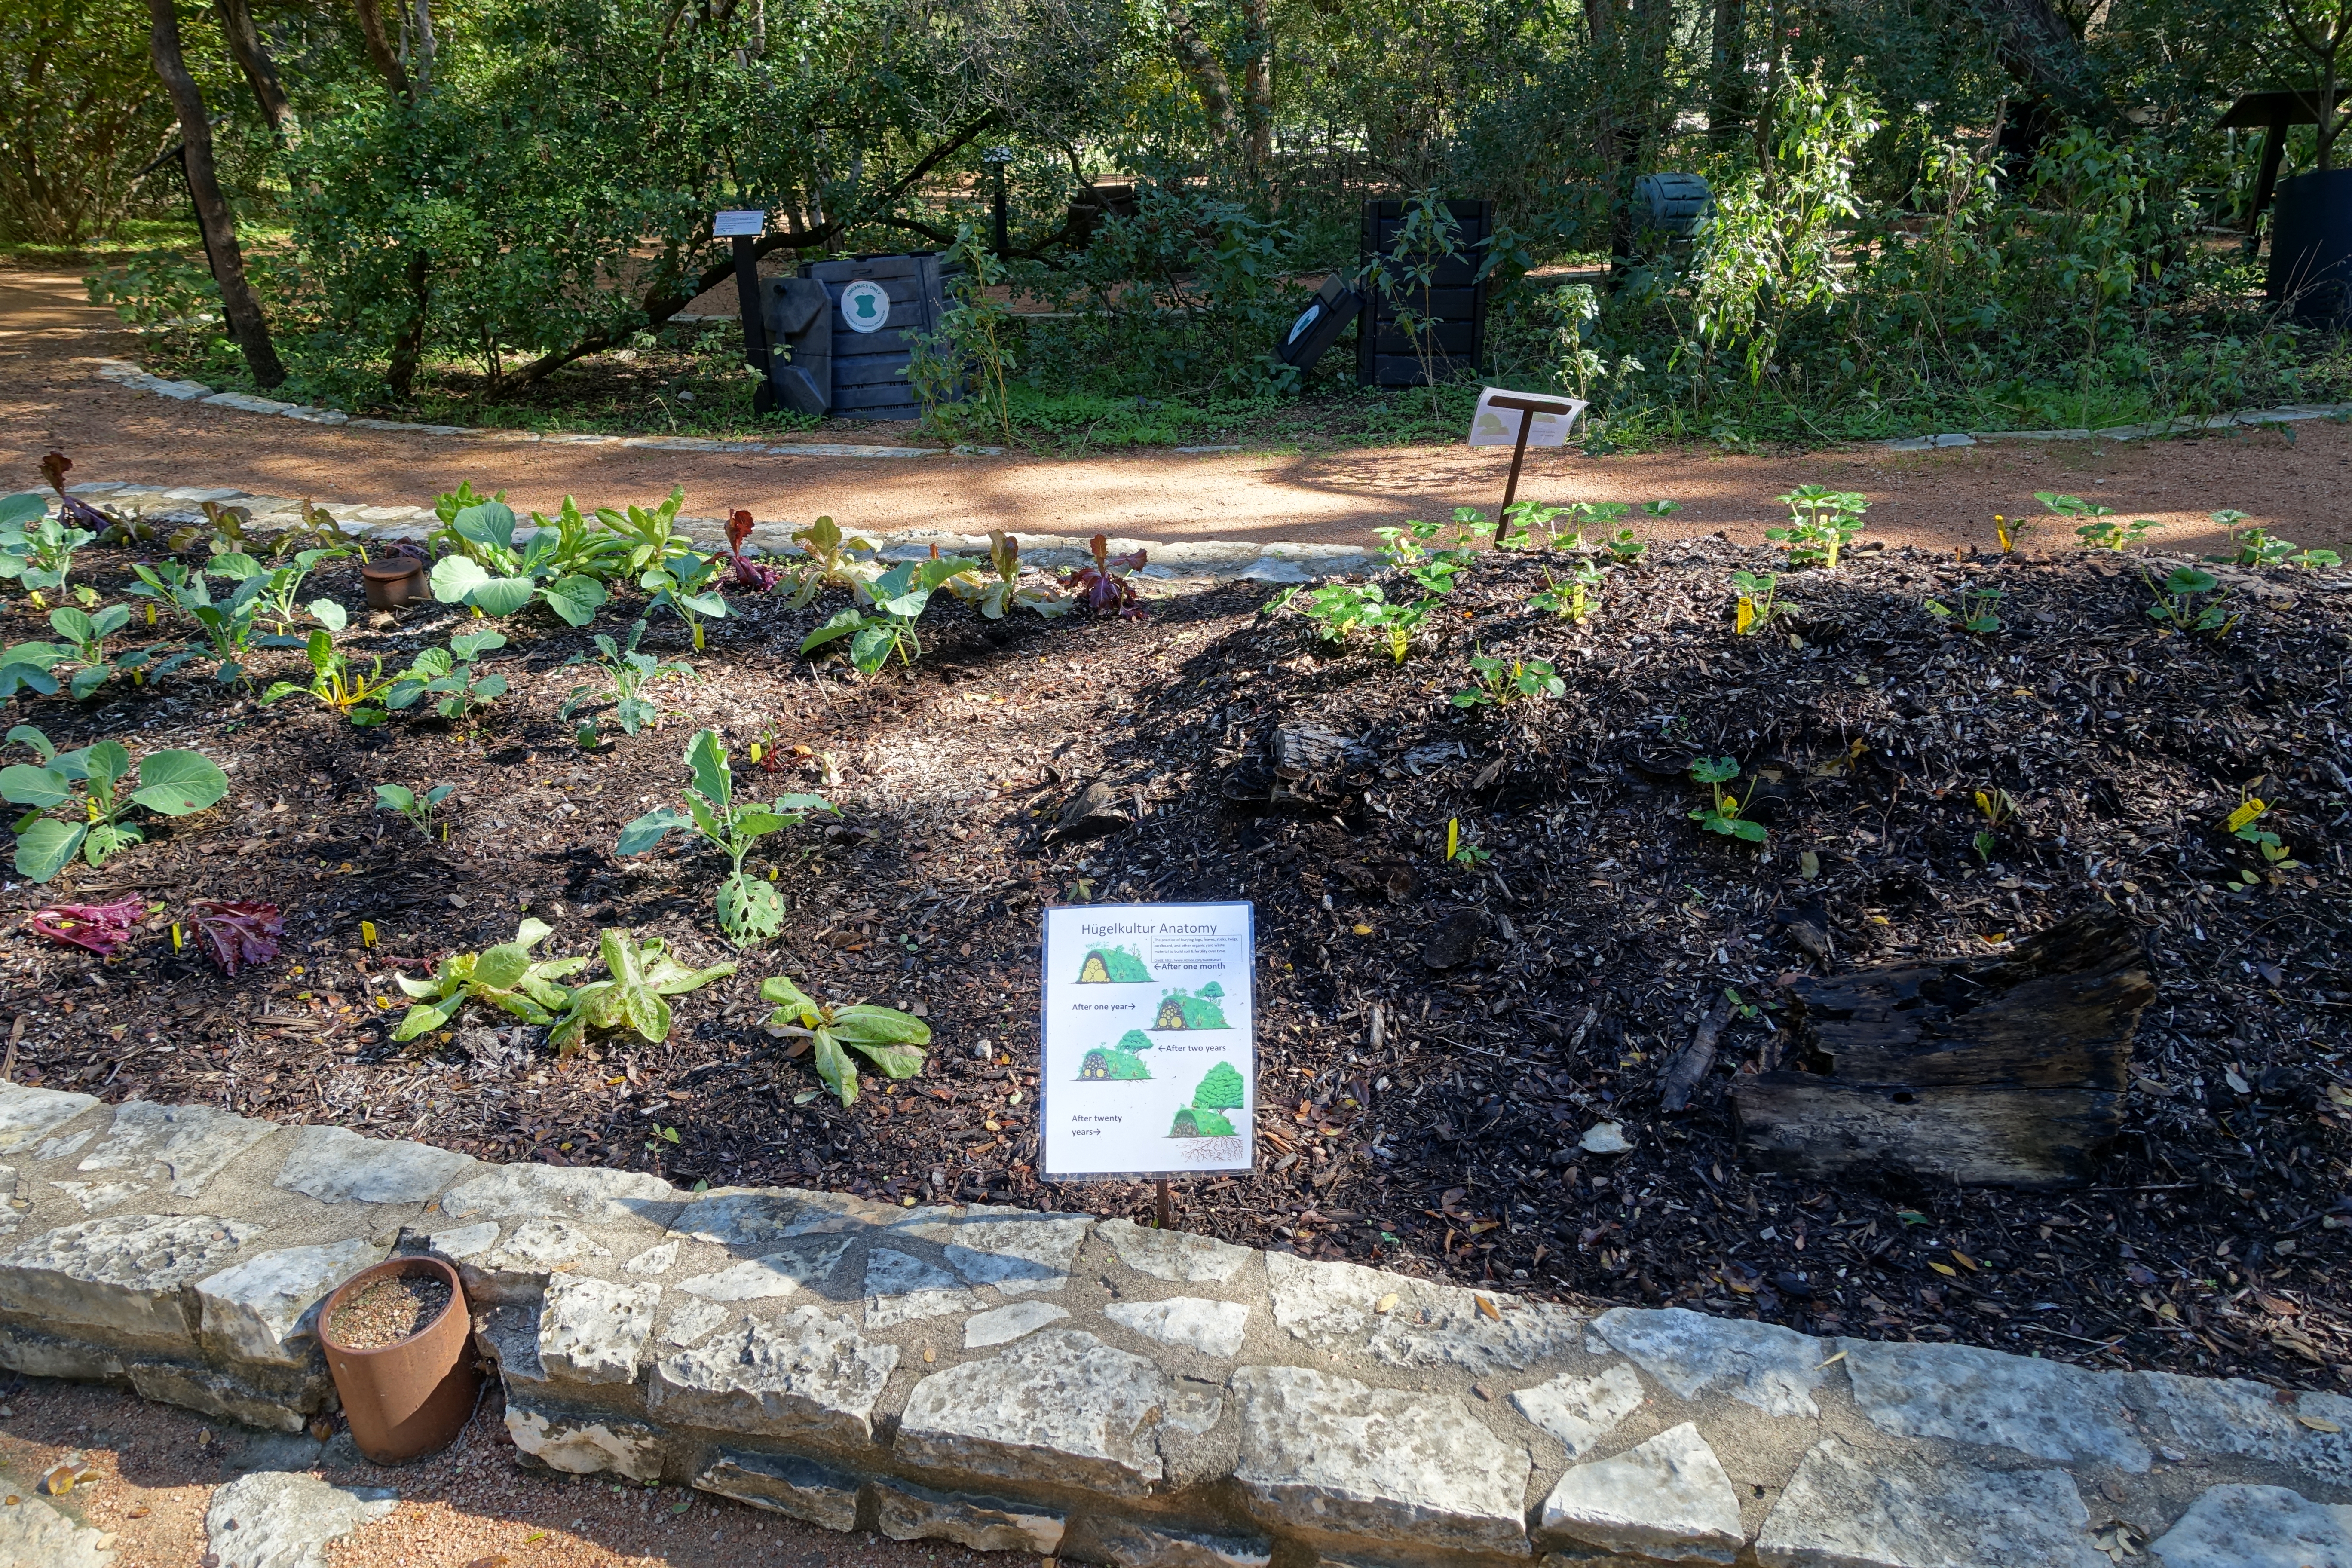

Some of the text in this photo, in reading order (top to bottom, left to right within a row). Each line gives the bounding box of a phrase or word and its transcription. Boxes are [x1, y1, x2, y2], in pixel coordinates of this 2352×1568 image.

[847, 284, 882, 297] ORGANICS ONLY
[1082, 922, 1217, 937] Hügelkultur Anatomy
[1094, 1115, 1122, 1123] twenty
